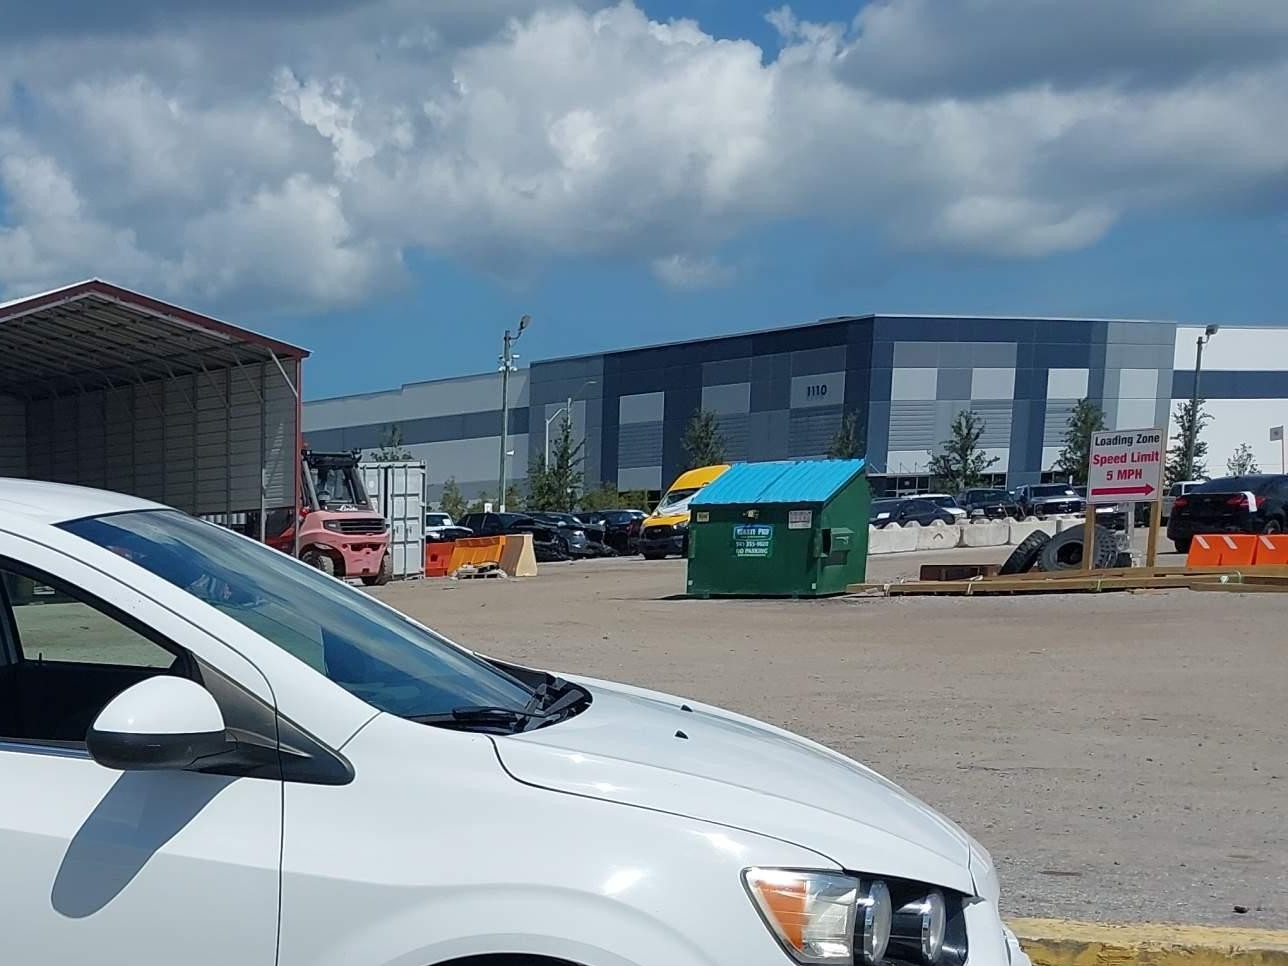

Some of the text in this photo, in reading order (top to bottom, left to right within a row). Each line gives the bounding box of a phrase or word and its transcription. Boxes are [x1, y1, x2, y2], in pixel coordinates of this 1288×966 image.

[807, 384, 828, 397] 1110
[1095, 434, 1160, 446] Loading Zone
[1093, 450, 1159, 466] Speed Limit
[1106, 468, 1143, 481] 5 MPH
